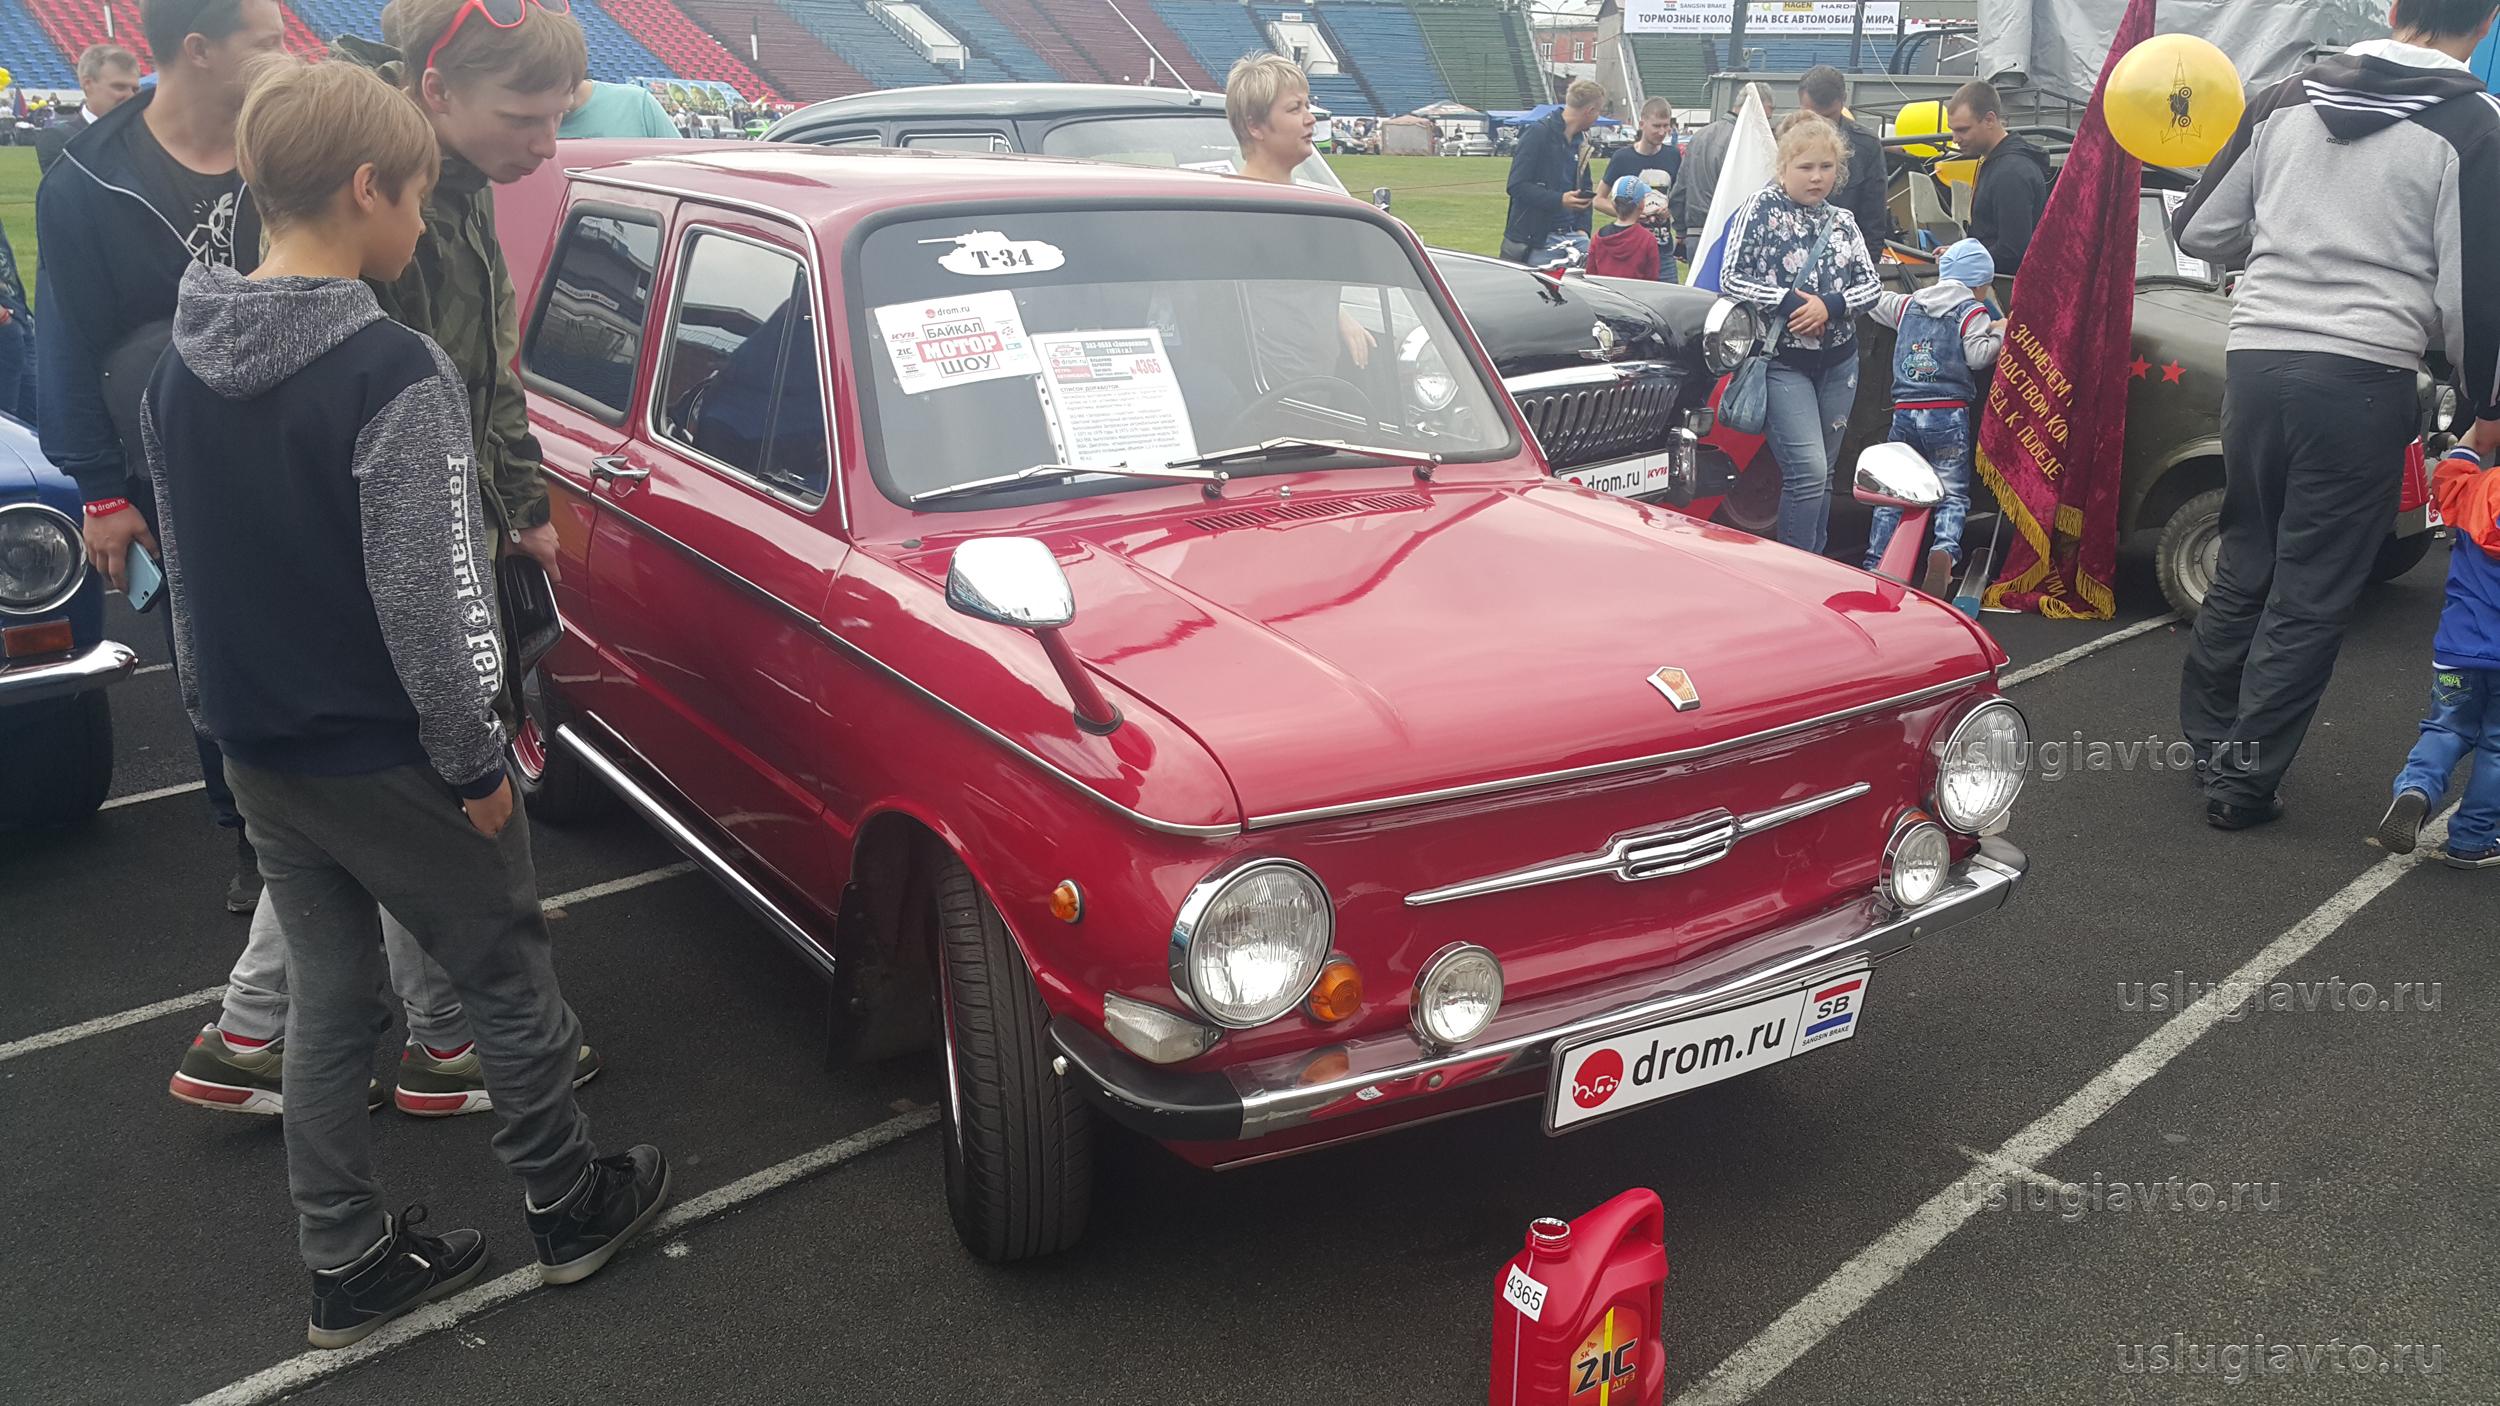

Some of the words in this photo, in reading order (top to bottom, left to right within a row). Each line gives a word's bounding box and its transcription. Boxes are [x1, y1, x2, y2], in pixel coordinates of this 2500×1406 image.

[1784, 0, 1812, 8] HAGEN
[1639, 14, 1700, 23] ТОРМОЗНЫЕ
[1703, 14, 1753, 24] КОЛОИ
[1756, 15, 1768, 24] НА
[1771, 15, 1789, 24] ВСЕ
[1791, 15, 1856, 24] АВТОМОБИЛ
[1865, 15, 1894, 24] МИРА
[937, 305, 970, 317] drom.ru
[926, 321, 982, 339] БАЙКАЛ
[896, 347, 913, 356] ZIC
[921, 334, 998, 362] МОТОР
[941, 355, 992, 374] ШОУ
[2010, 324, 2073, 398] ЗНАМЕНЕМ
[2005, 411, 2024, 428] К
[2017, 425, 2065, 481] ПОБЕДЕ
[1587, 470, 1640, 492] drom.ru
[97, 498, 125, 511] drom.ru
[1817, 995, 1850, 1020] SB
[1802, 1032, 1828, 1047] SANGSIN
[1829, 1025, 1849, 1037] BRAKE
[1632, 1018, 1785, 1086] drom.ru
[1507, 1275, 1543, 1311] 4365
[1573, 1337, 1638, 1396] ZIC
